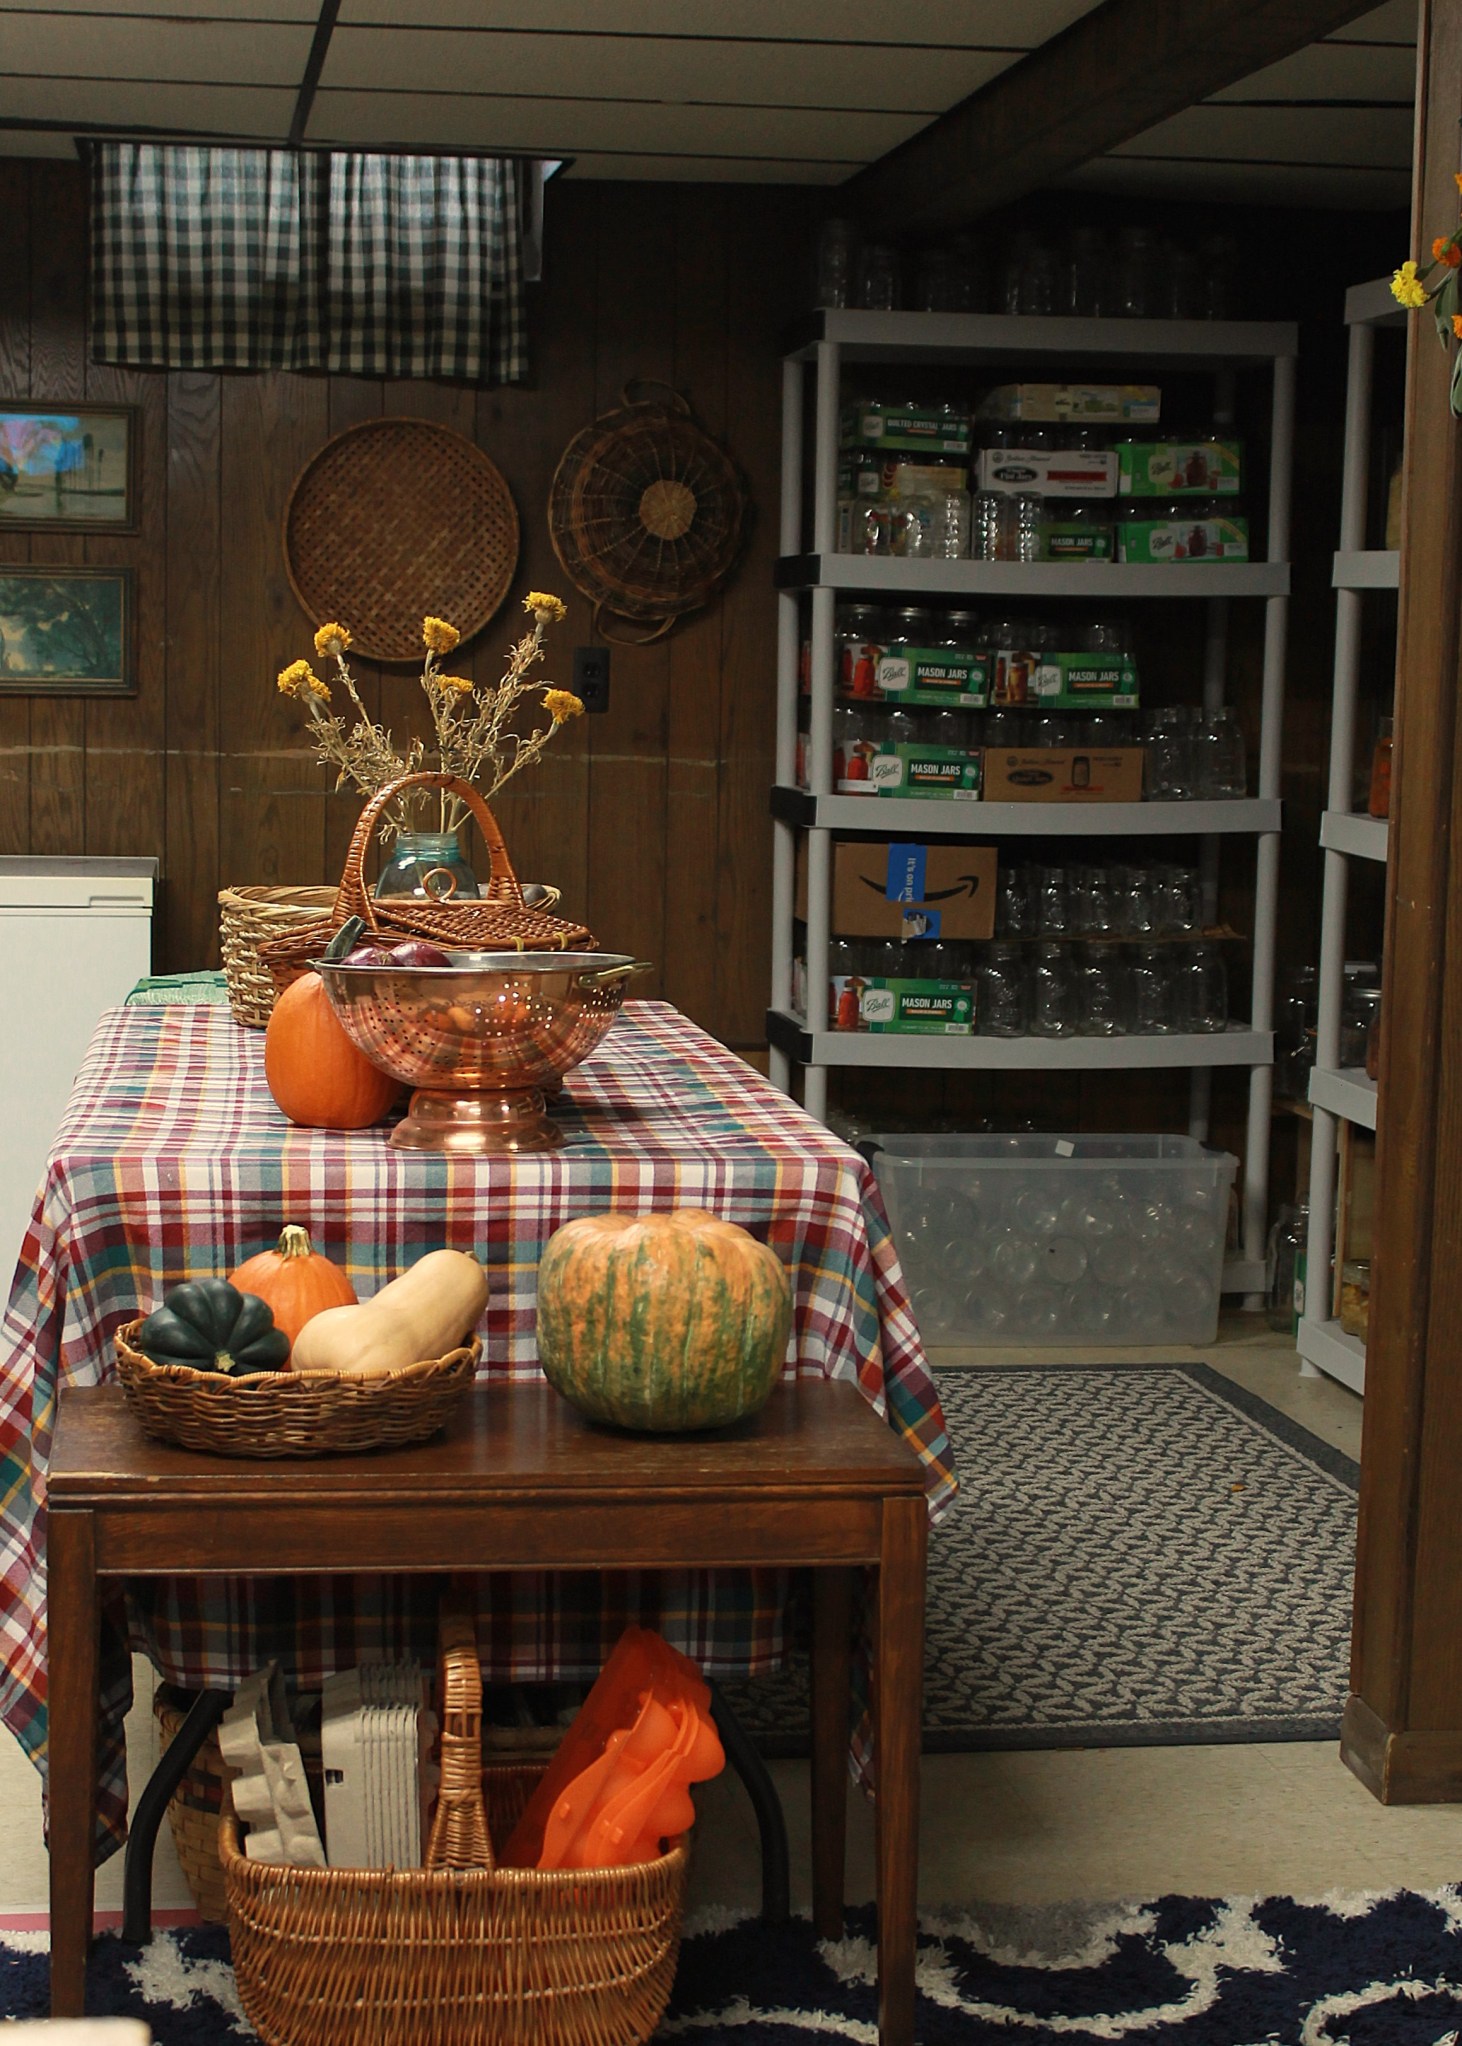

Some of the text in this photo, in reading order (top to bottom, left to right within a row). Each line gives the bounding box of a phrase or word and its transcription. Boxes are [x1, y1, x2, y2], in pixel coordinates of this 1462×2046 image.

[1051, 538, 1093, 546] MASON JARS
[882, 666, 906, 681] Ball
[917, 666, 968, 680] MASON JARS
[1068, 671, 1119, 681] MASON JARS
[875, 763, 900, 779] Ball
[910, 763, 961, 776] MASON JARS
[907, 857, 917, 872] It's
[906, 874, 914, 886] on
[866, 998, 891, 1013] Ball
[901, 997, 952, 1009] MASON JARS
